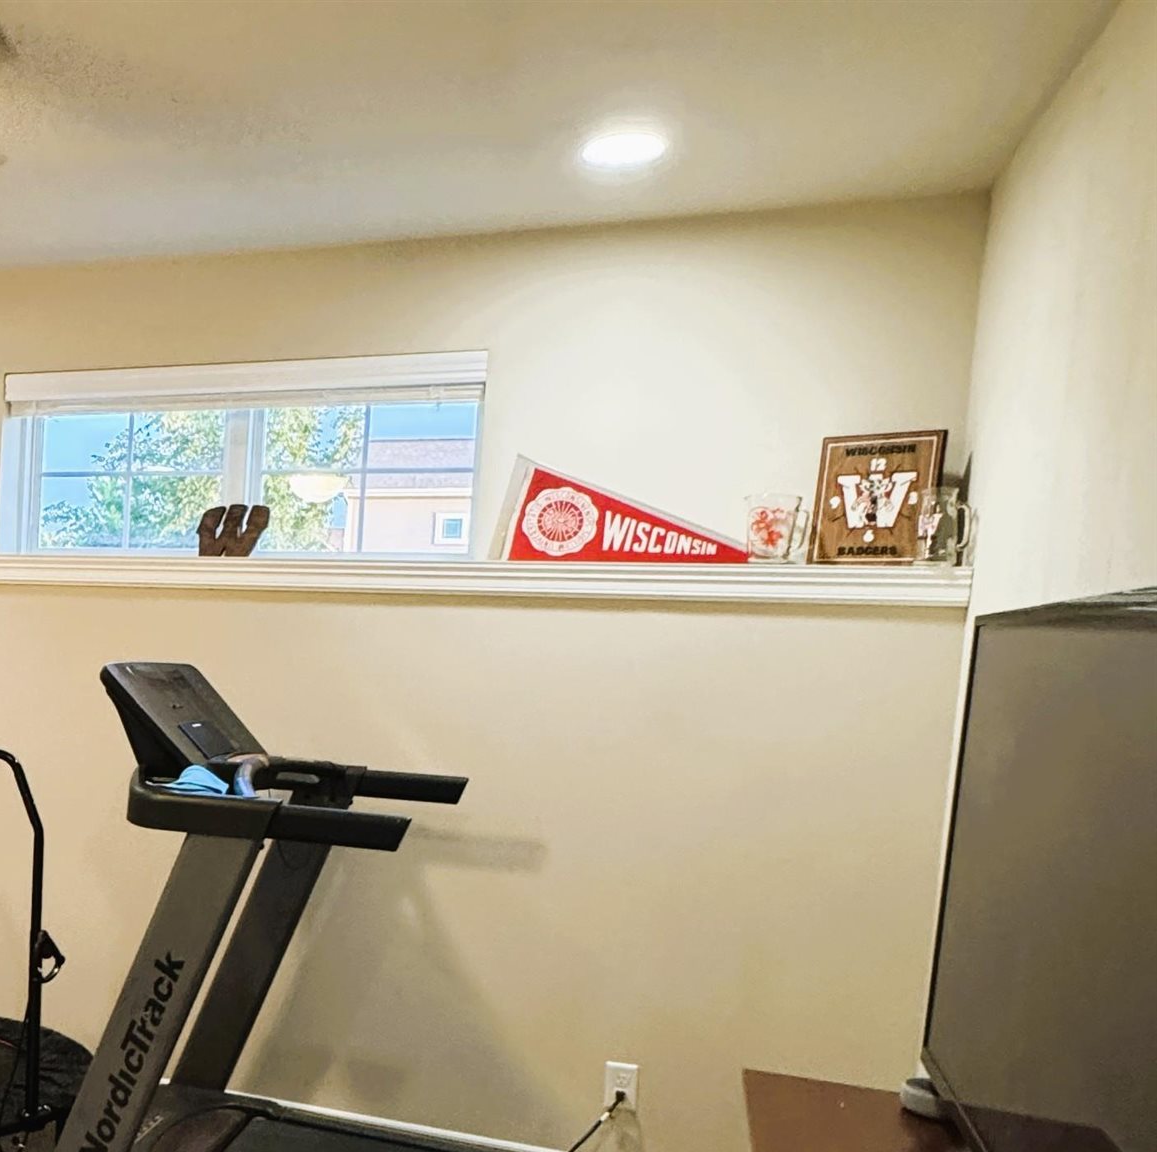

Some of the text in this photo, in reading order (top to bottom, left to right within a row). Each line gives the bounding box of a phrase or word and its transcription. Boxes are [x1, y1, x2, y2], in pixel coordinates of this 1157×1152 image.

[845, 443, 917, 457] WISCONSIN
[870, 457, 887, 472] 12
[602, 510, 718, 556] WISCONSIN
